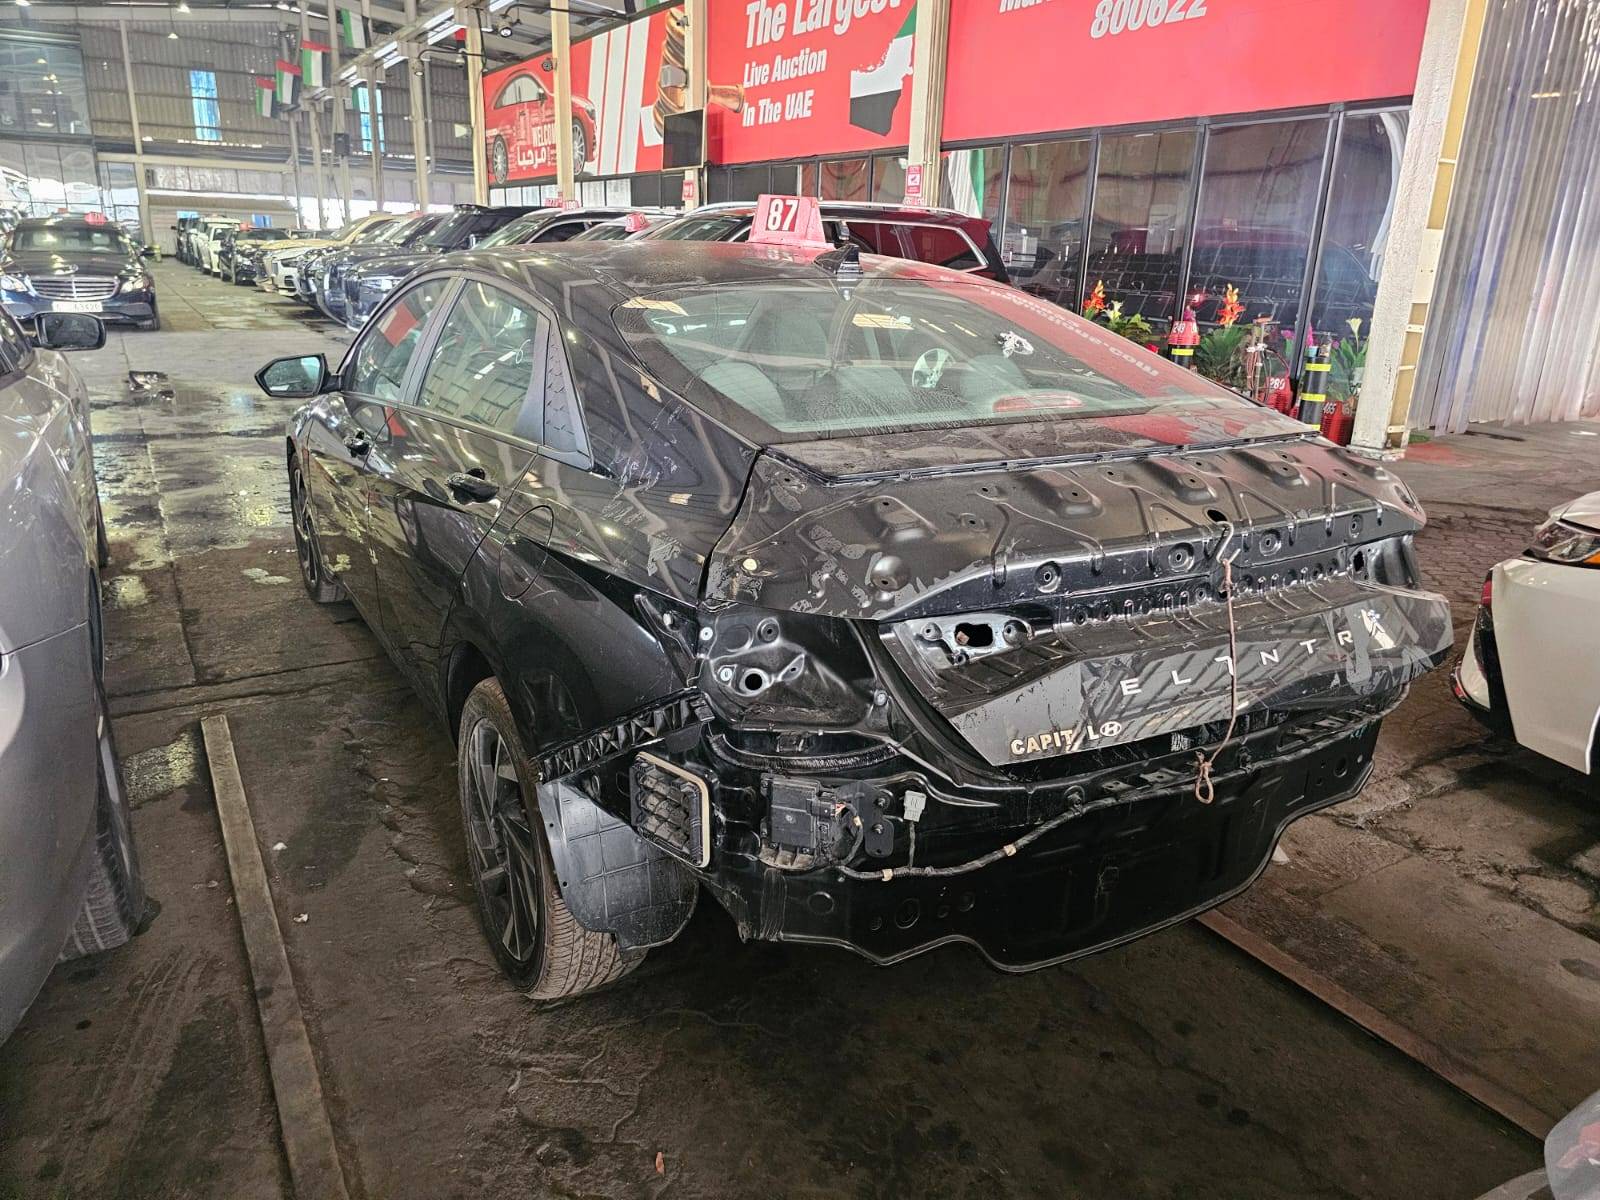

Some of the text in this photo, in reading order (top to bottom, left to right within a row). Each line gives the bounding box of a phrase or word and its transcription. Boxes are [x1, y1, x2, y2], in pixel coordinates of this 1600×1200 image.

[746, 0, 901, 48] The Large
[743, 48, 828, 88] Live Auction
[742, 90, 815, 127] In The UAE
[516, 147, 547, 170] مرحبا
[767, 198, 799, 231] 87
[1010, 724, 1100, 756] CAPITL
